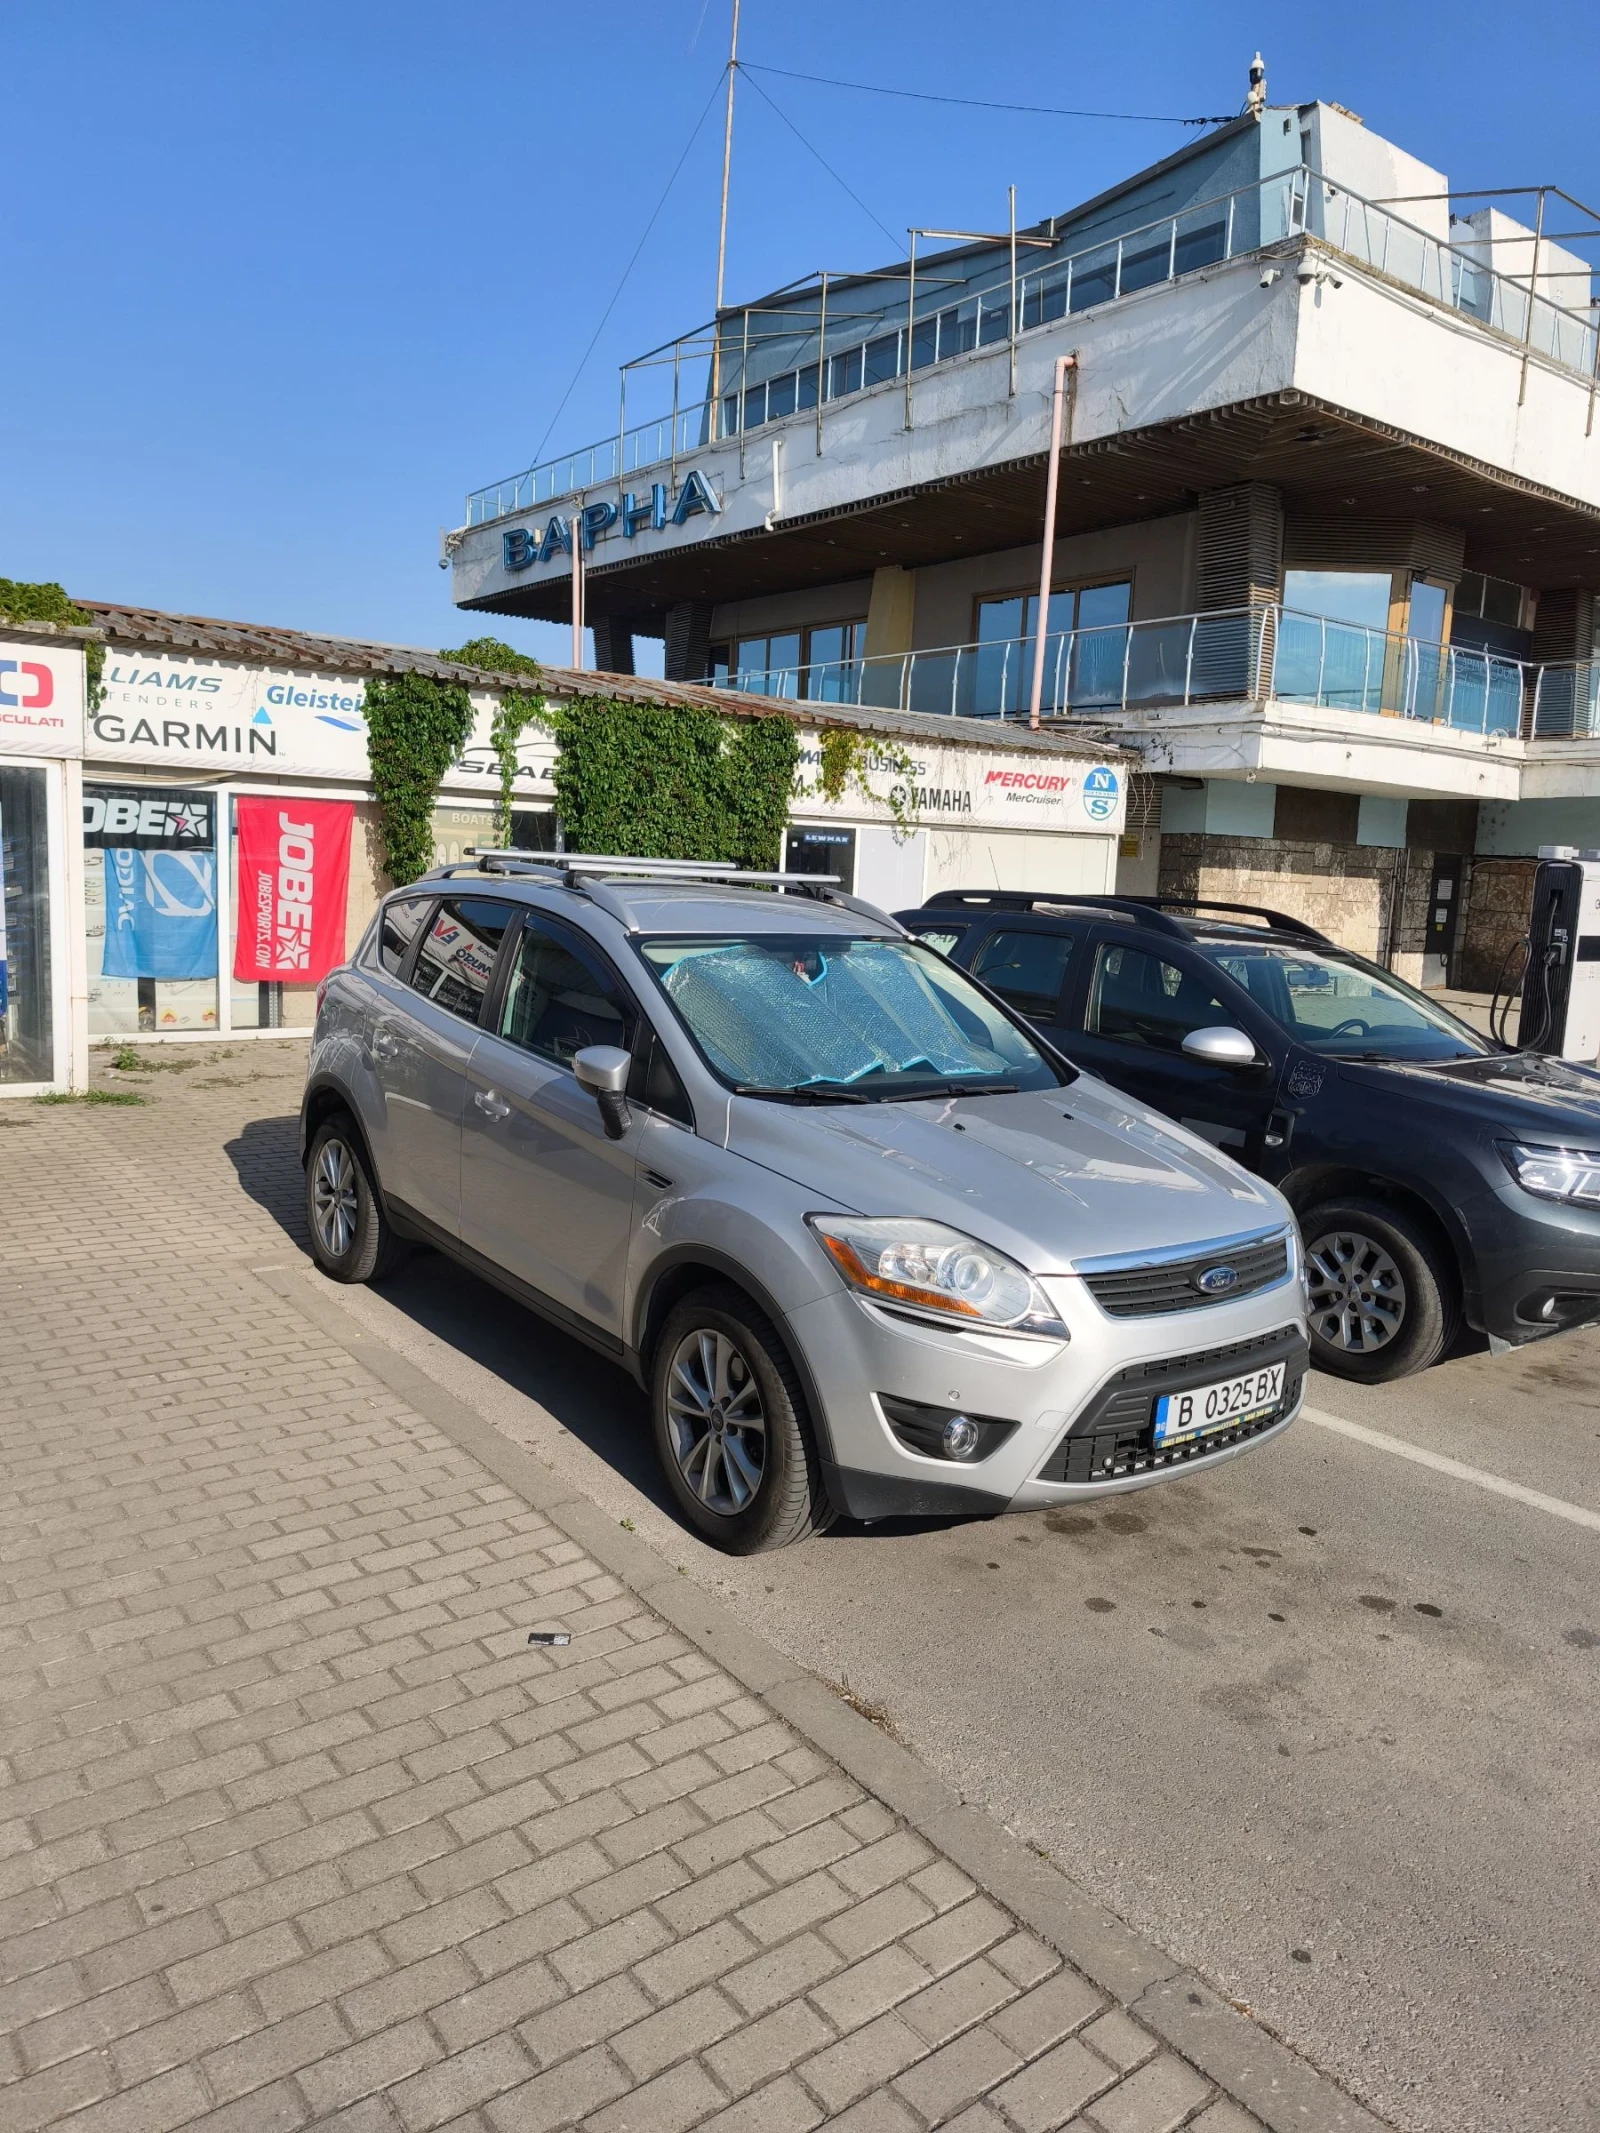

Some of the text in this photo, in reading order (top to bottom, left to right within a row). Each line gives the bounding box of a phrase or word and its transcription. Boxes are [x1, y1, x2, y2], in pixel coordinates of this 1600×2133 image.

[502, 469, 723, 572] ВАРНА
[107, 691, 213, 710] TENDERS
[0, 714, 64, 727] CULATI
[93, 714, 276, 756] GARMIN
[984, 770, 1071, 791] MERCURY
[1006, 792, 1062, 806] MerCruiser
[805, 834, 849, 843] LEWMAR
[278, 811, 315, 931] JOBE
[255, 869, 273, 969] JOBESPORTS.COM
[1178, 1396, 1193, 1428] B
[1155, 1423, 1166, 1433] BG
